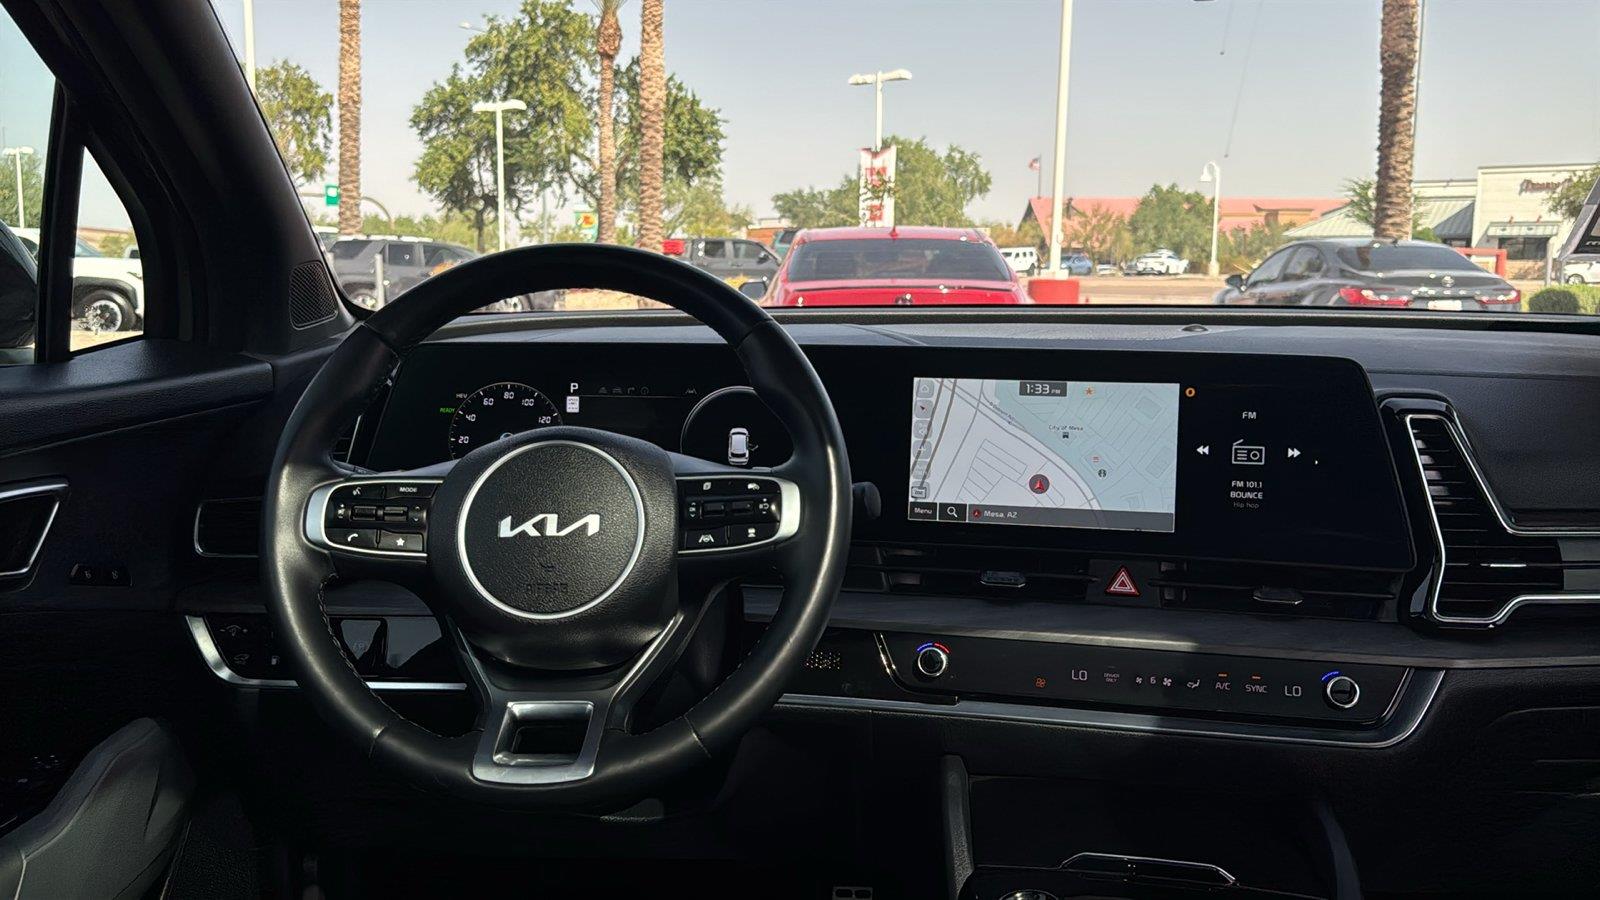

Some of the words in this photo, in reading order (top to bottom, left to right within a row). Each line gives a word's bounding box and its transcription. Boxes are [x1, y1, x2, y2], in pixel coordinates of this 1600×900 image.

[570, 382, 579, 394] P
[1026, 383, 1050, 394] 1:33
[503, 391, 515, 400] 80
[483, 397, 495, 406] 60
[521, 399, 535, 407] 100
[465, 414, 477, 422] 40
[1242, 411, 1257, 419] FM
[538, 416, 552, 424] 120
[458, 436, 470, 444] 20
[1231, 480, 1244, 488] FM
[1246, 481, 1263, 489] 101.1
[1230, 491, 1263, 500] BOUNCE
[1233, 501, 1245, 509] Hip
[498, 513, 601, 538] KIA
[1071, 669, 1088, 681] LO
[1215, 682, 1231, 691] A/C
[1244, 684, 1269, 693] SYNC
[1284, 685, 1302, 697] LO
